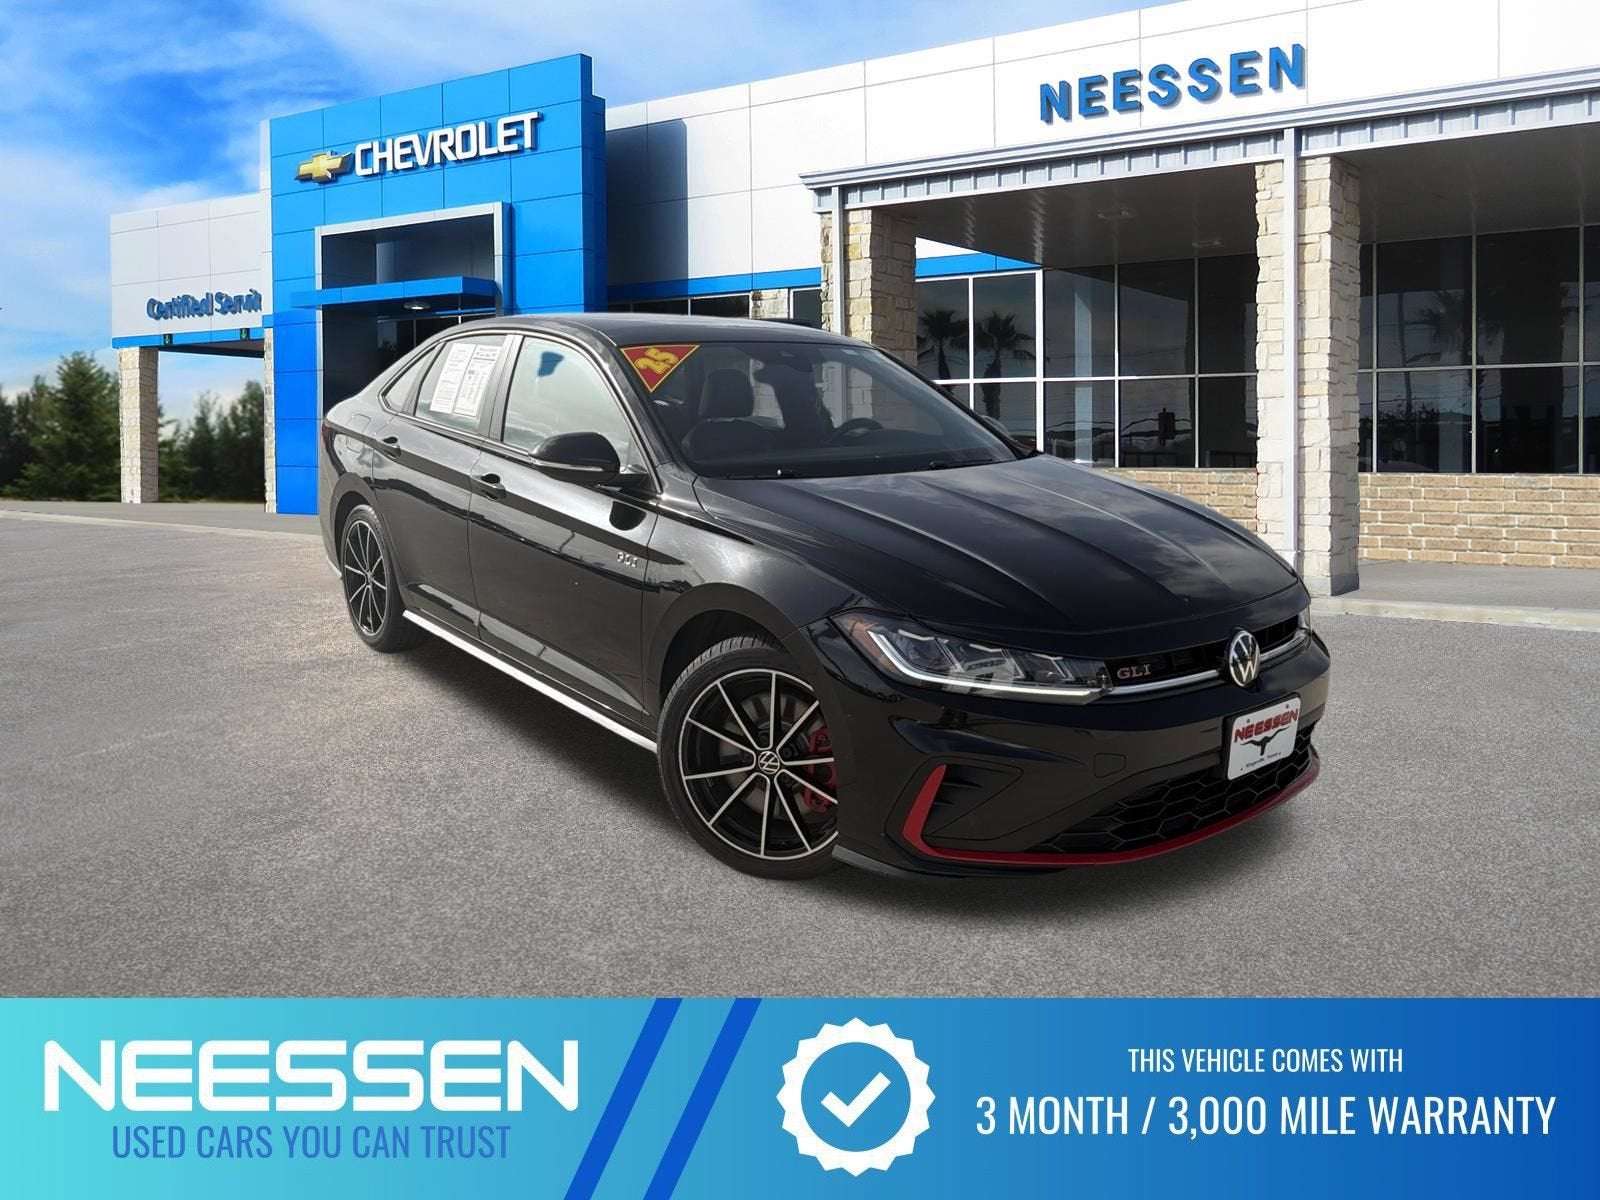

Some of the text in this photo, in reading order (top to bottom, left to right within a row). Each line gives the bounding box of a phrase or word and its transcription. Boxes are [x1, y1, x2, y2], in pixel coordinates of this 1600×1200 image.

[1040, 44, 1305, 125] NEESSEN
[355, 111, 541, 177] CHEVROLET
[147, 292, 214, 320] Certified
[1117, 664, 1152, 680] GLI
[1234, 708, 1299, 743] NEESSEN
